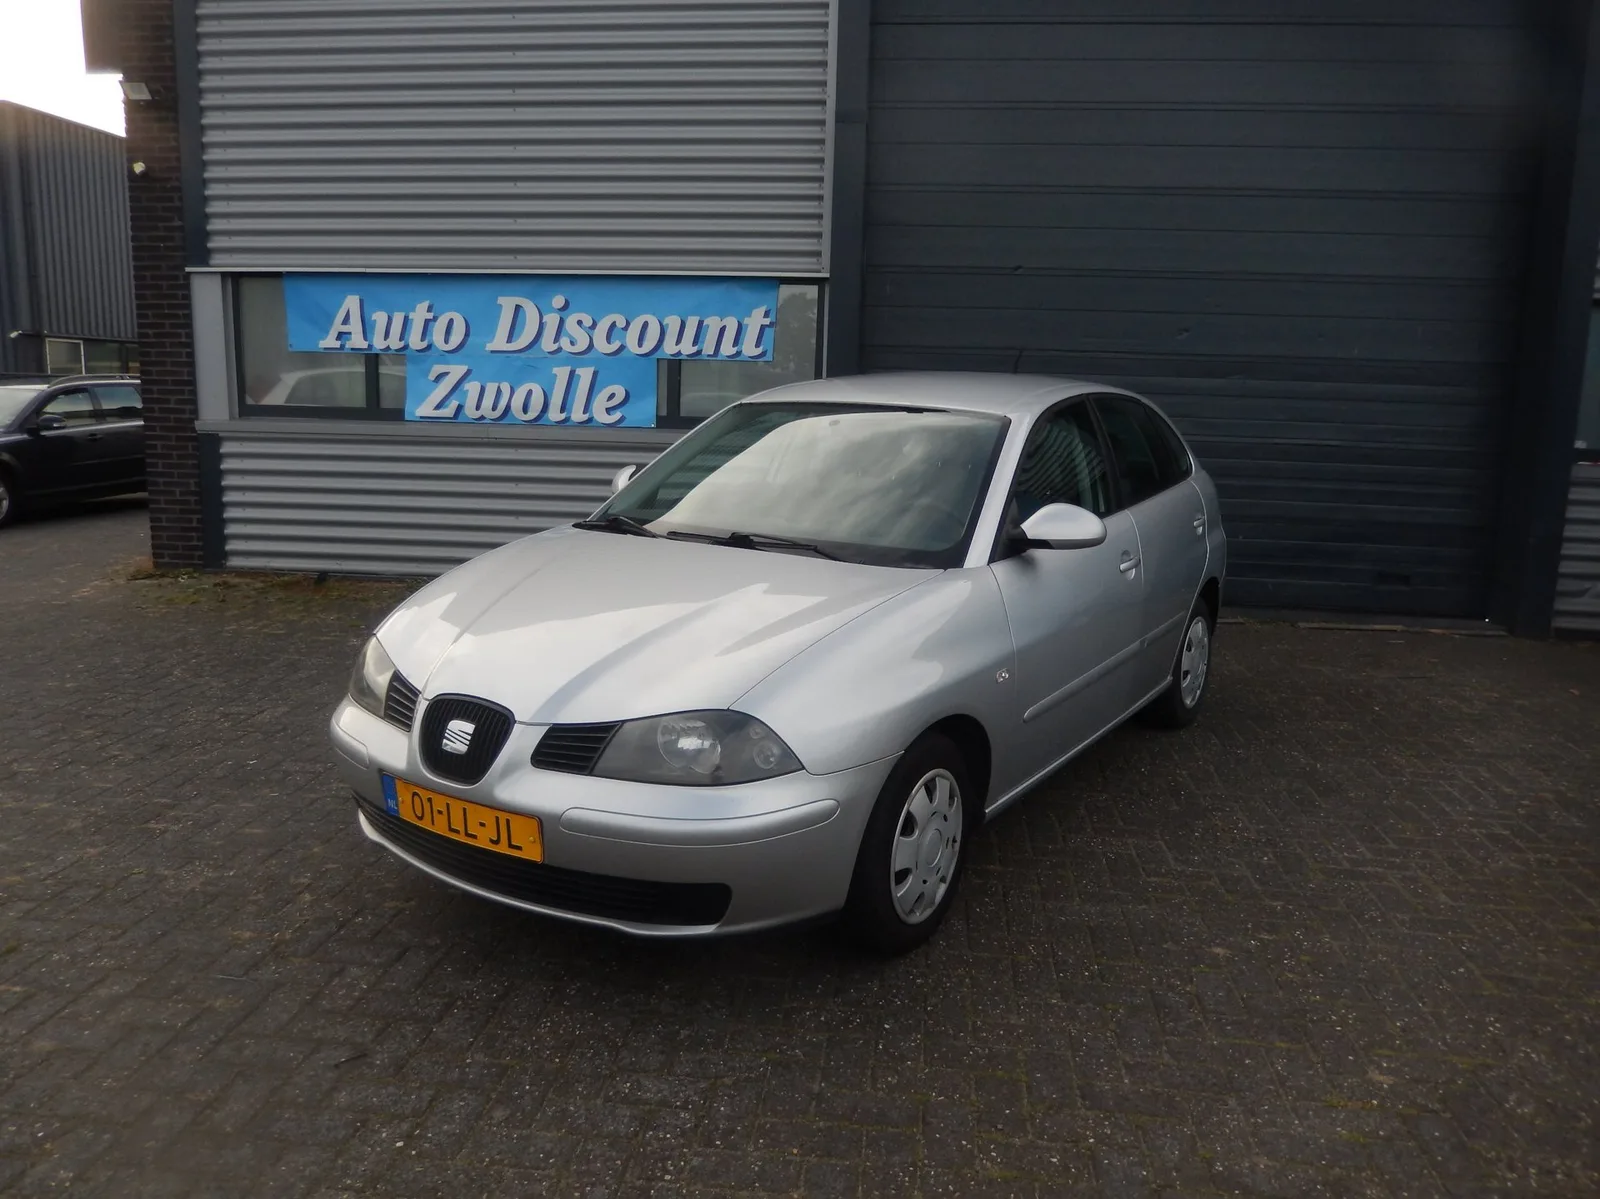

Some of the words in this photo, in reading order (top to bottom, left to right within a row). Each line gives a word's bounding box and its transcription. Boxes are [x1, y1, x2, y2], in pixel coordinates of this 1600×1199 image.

[318, 295, 470, 353] Auto
[485, 295, 773, 358] Discount
[416, 364, 630, 425] Zwolle
[387, 798, 398, 810] NL
[411, 791, 523, 851] 01-LL-JL
